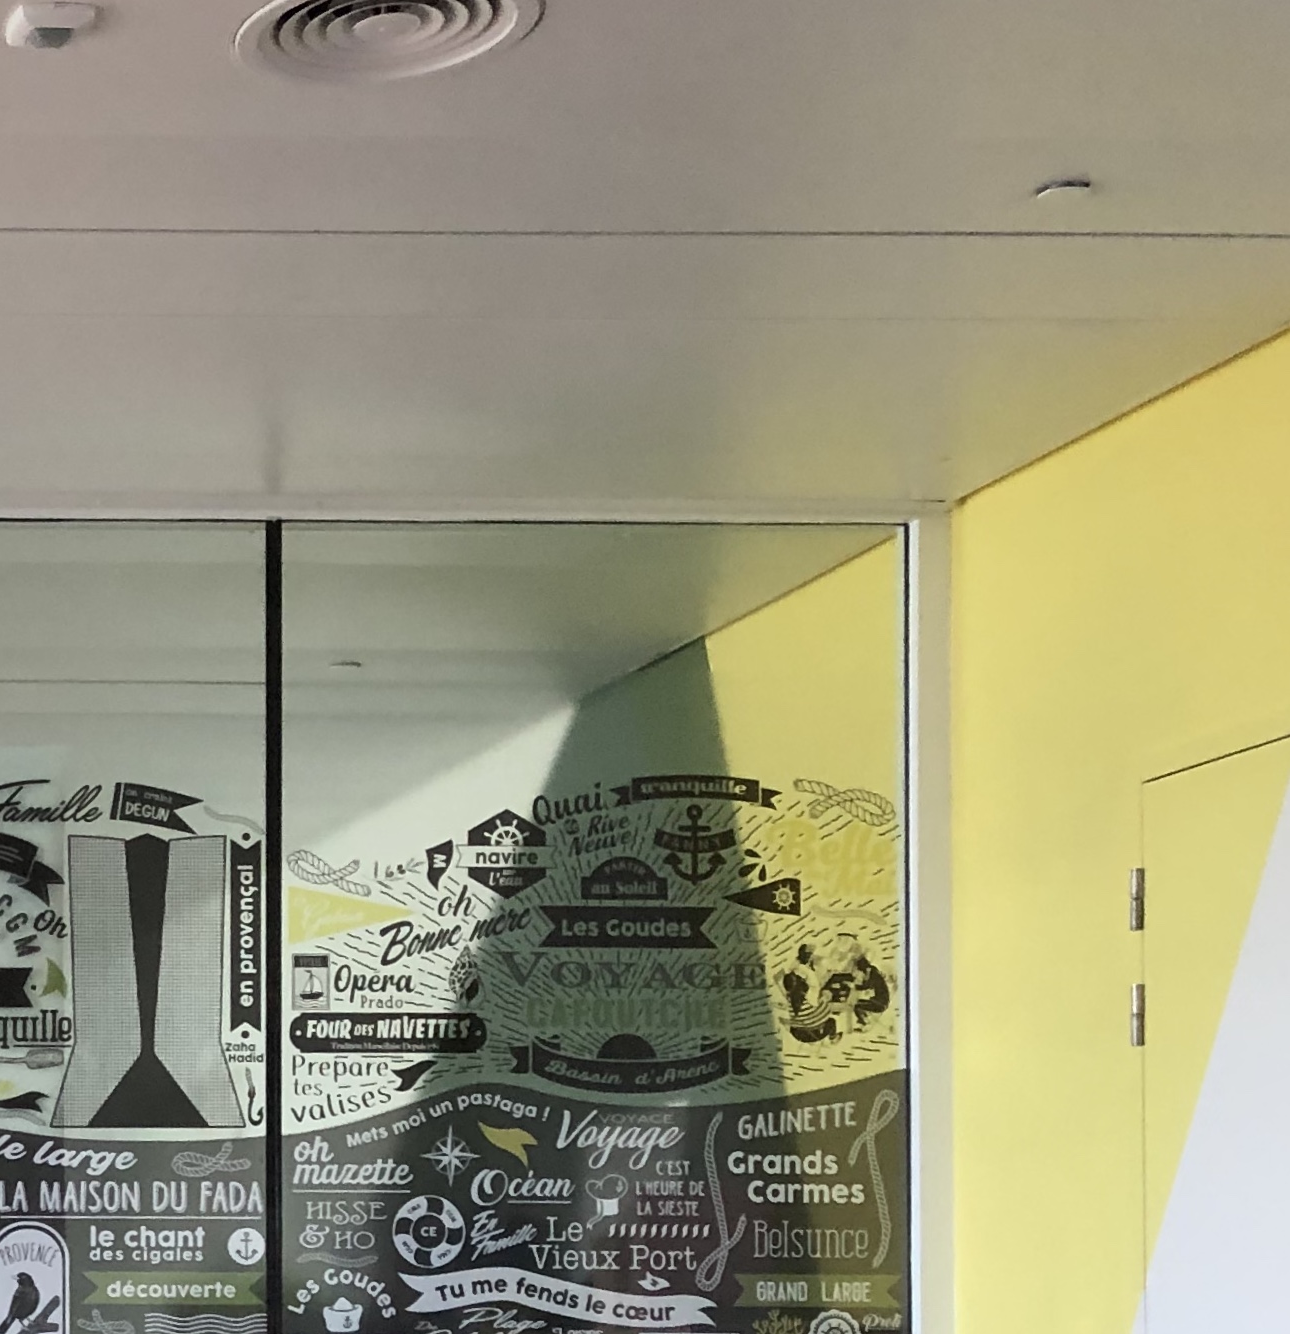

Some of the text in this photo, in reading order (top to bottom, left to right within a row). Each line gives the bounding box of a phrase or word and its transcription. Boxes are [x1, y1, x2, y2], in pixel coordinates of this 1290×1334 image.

[475, 849, 539, 866] navire
[561, 918, 691, 938] Les Goudes
[306, 1016, 471, 1039] FOUR DES NAVETTES
[738, 1101, 857, 1141] GALINETTE
[556, 1109, 686, 1170] Voyage
[33, 1139, 138, 1176] large
[727, 1150, 838, 1175] Grands
[39, 1180, 142, 1214] MAISON
[152, 1182, 188, 1213] DU
[200, 1180, 264, 1214] FADA
[747, 1180, 865, 1206] Carmes
[306, 1200, 389, 1225] HISSE
[90, 1225, 205, 1248] le chant
[546, 1216, 584, 1242] Le
[753, 1219, 869, 1259] Belsunce
[90, 1248, 205, 1264] des cigales
[528, 1244, 698, 1273] Vieux Port
[106, 1281, 236, 1298] découverte
[434, 1276, 676, 1323] Tu me fends le cœur
[756, 1281, 871, 1302] GRAND LARGE
